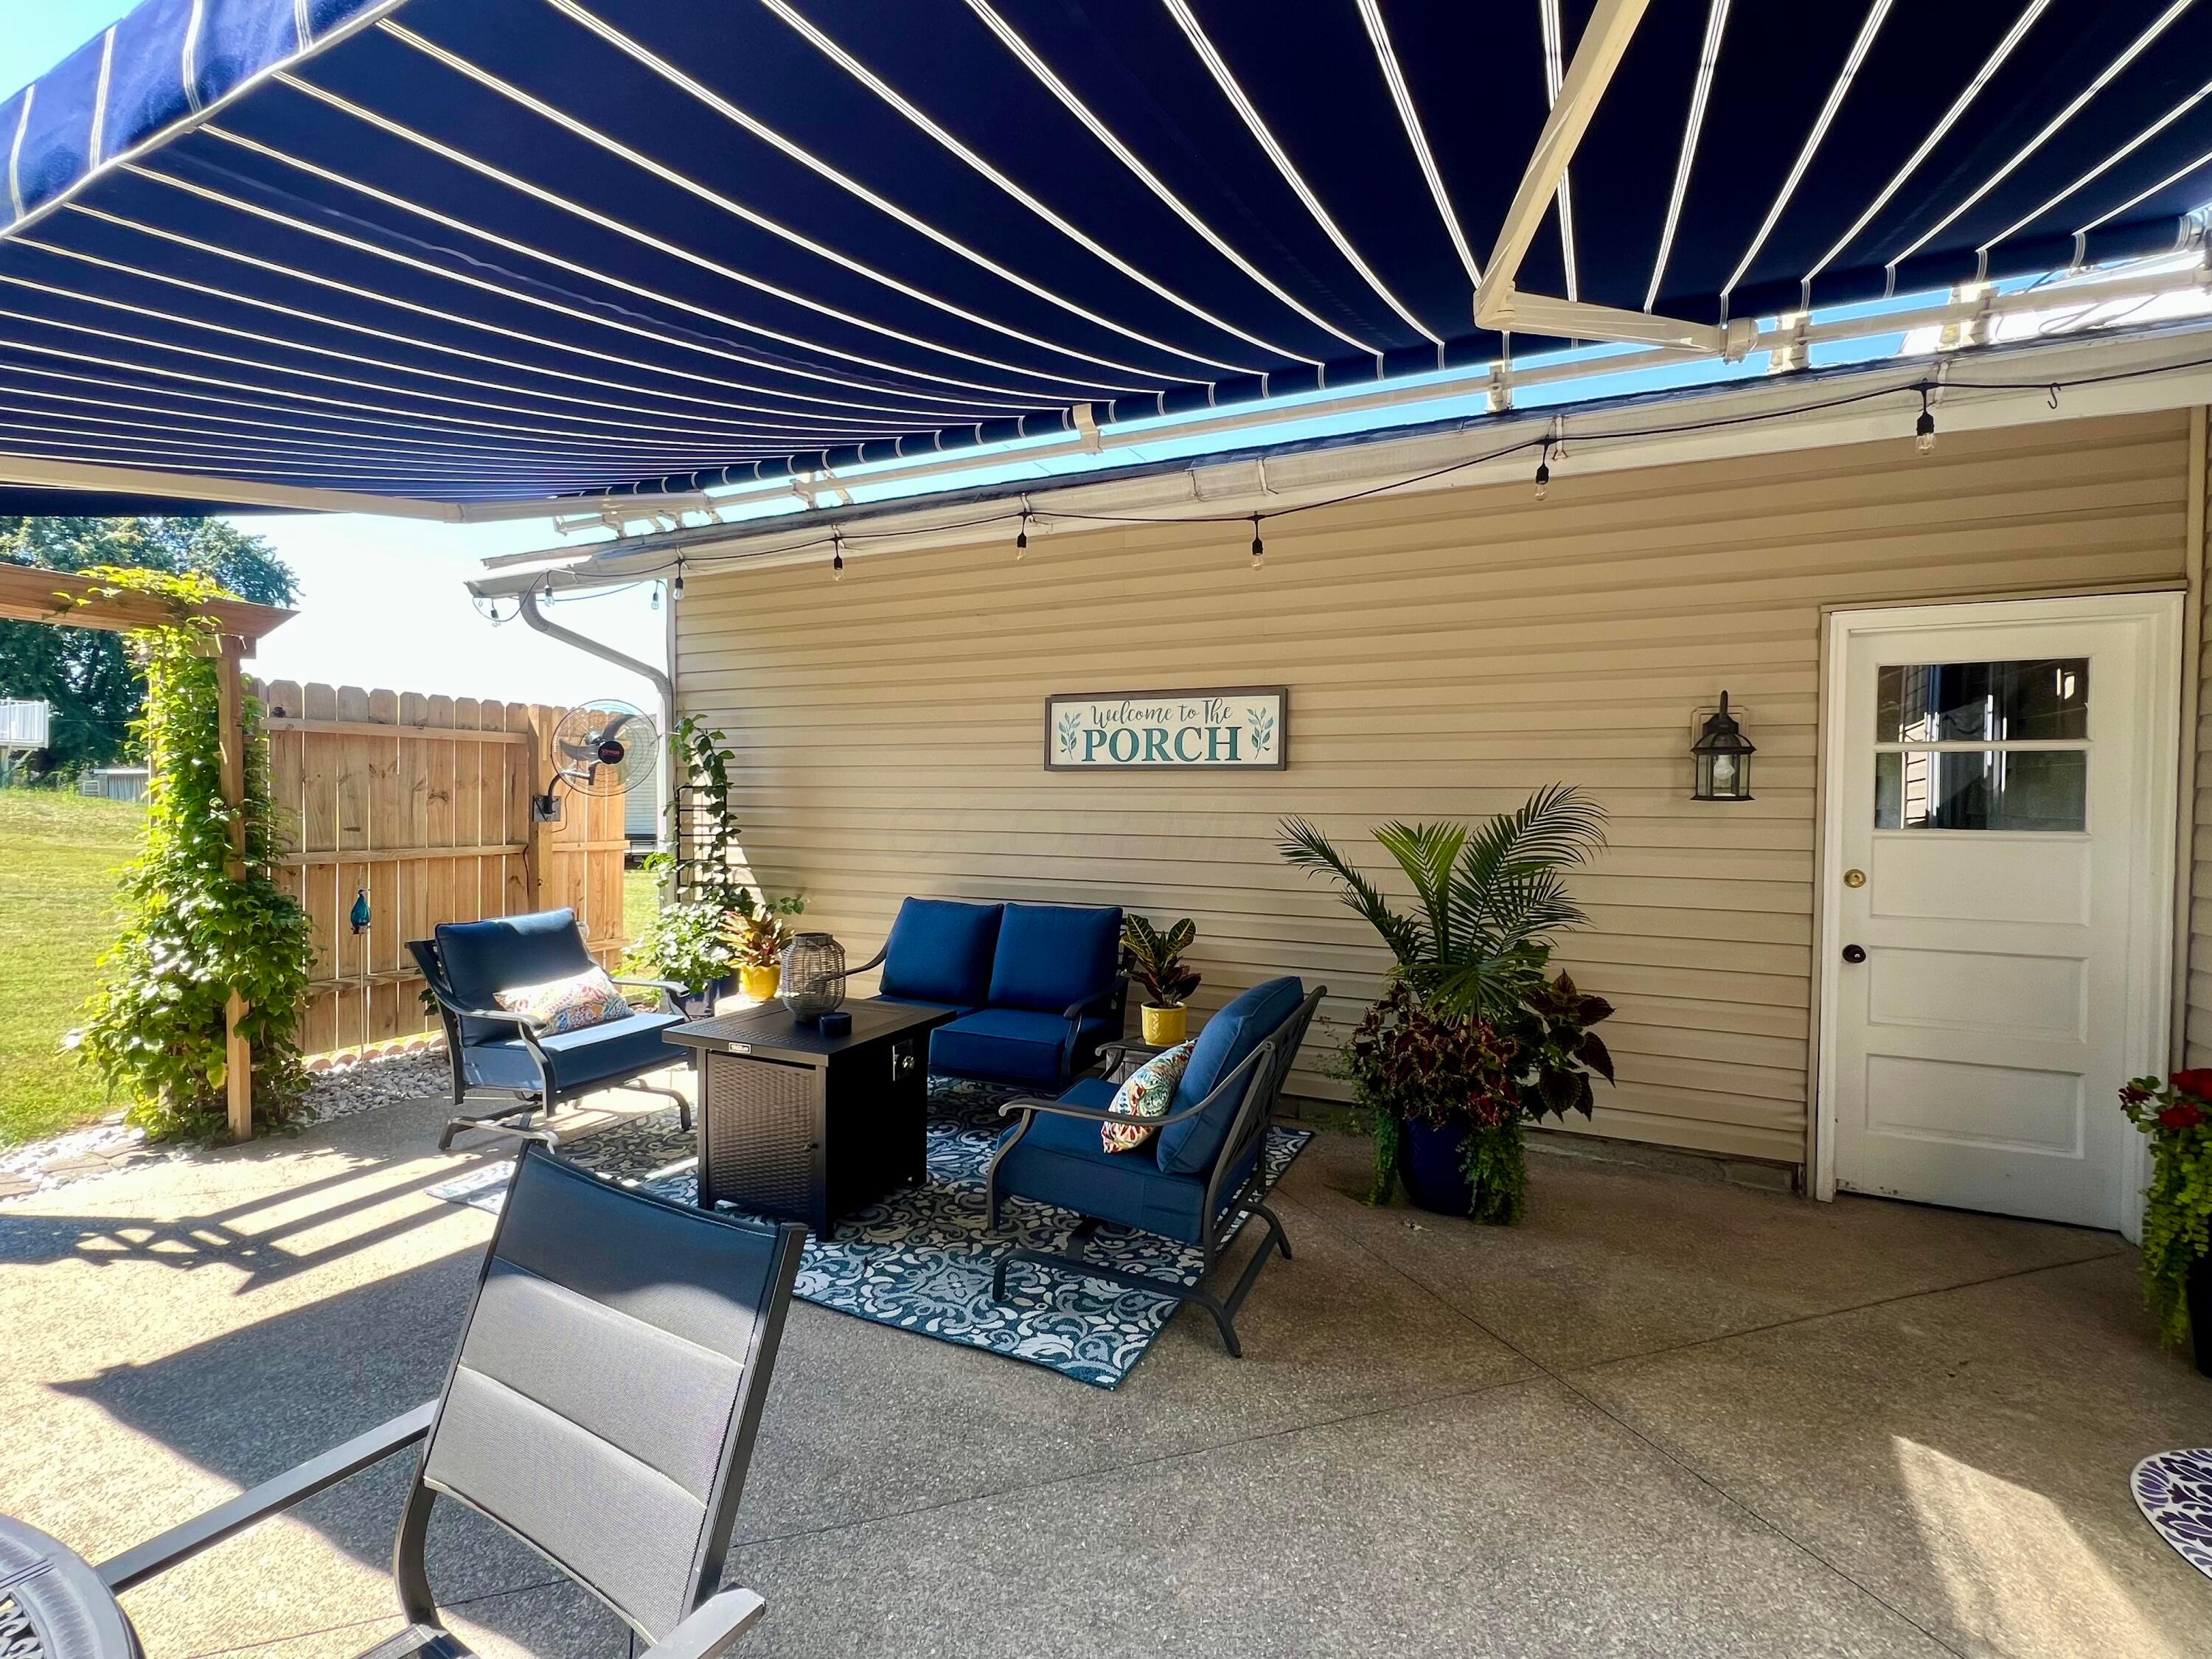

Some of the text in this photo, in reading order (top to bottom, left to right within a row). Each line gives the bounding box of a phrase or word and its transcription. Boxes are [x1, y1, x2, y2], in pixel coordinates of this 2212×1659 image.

[1091, 698, 1233, 728] Welcome to The
[1082, 726, 1242, 762] PORCH
